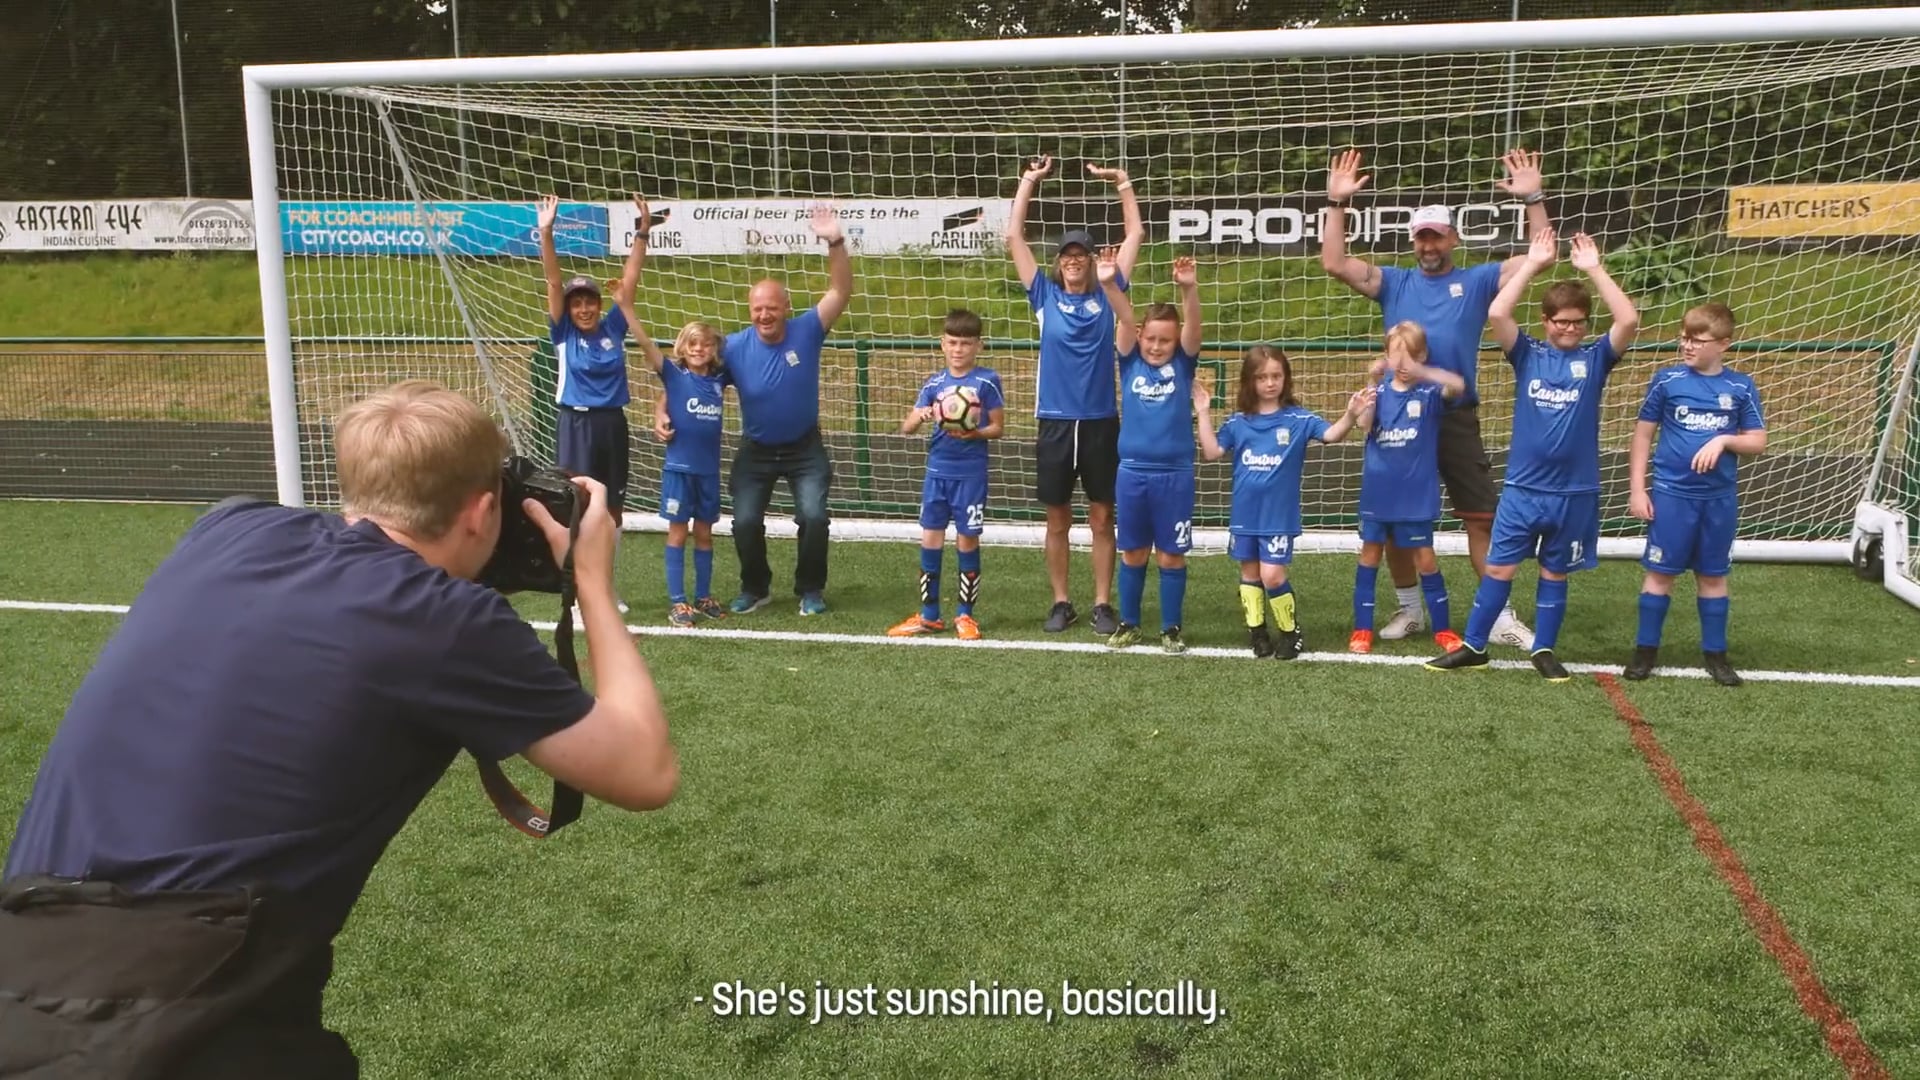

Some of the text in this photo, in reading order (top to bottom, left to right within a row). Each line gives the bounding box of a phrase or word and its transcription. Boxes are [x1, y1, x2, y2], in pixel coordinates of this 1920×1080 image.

[693, 206, 919, 221] Official beer paners to the
[1735, 197, 1871, 219] THATCHERS
[15, 204, 142, 234] EASTERN EYE
[290, 210, 320, 225] FOR
[324, 210, 383, 225] COACH
[1168, 203, 1526, 244] PRO:DIRCT
[42, 236, 117, 246] INDIAN CUISINE
[624, 231, 682, 248] CLING
[745, 229, 807, 245] Devon
[931, 231, 994, 249] CARLING
[1528, 379, 1579, 402] Canine
[1674, 405, 1729, 428] Canine
[1242, 449, 1282, 466] Canine
[966, 504, 984, 526] 25
[1267, 535, 1288, 553] 34
